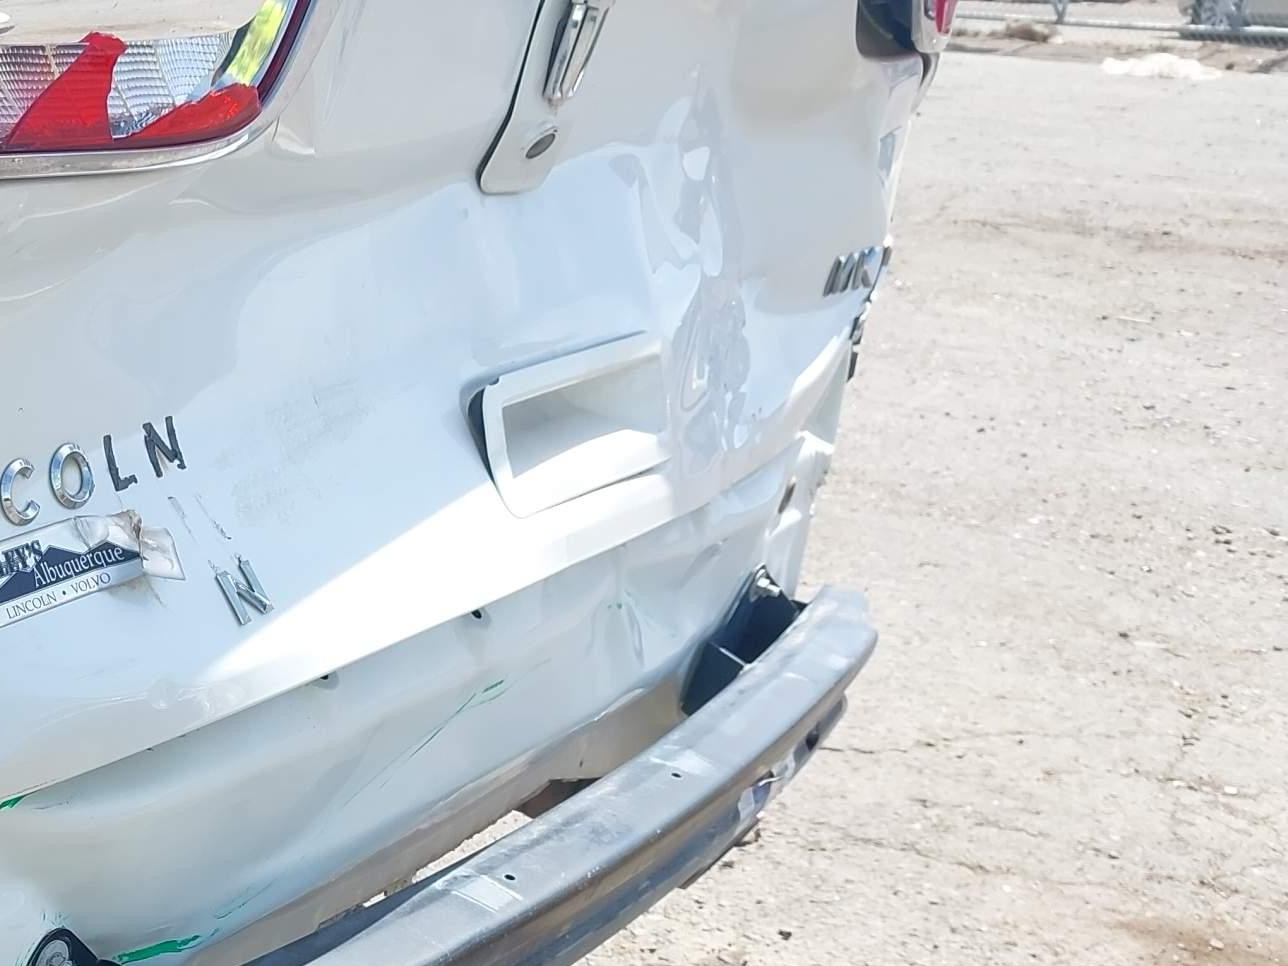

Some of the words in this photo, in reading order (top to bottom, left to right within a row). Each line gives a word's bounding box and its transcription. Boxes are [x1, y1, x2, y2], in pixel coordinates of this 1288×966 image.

[33, 545, 126, 588] Albuquerque
[6, 590, 58, 619] LINCOLN
[71, 572, 112, 594] VOLVO
